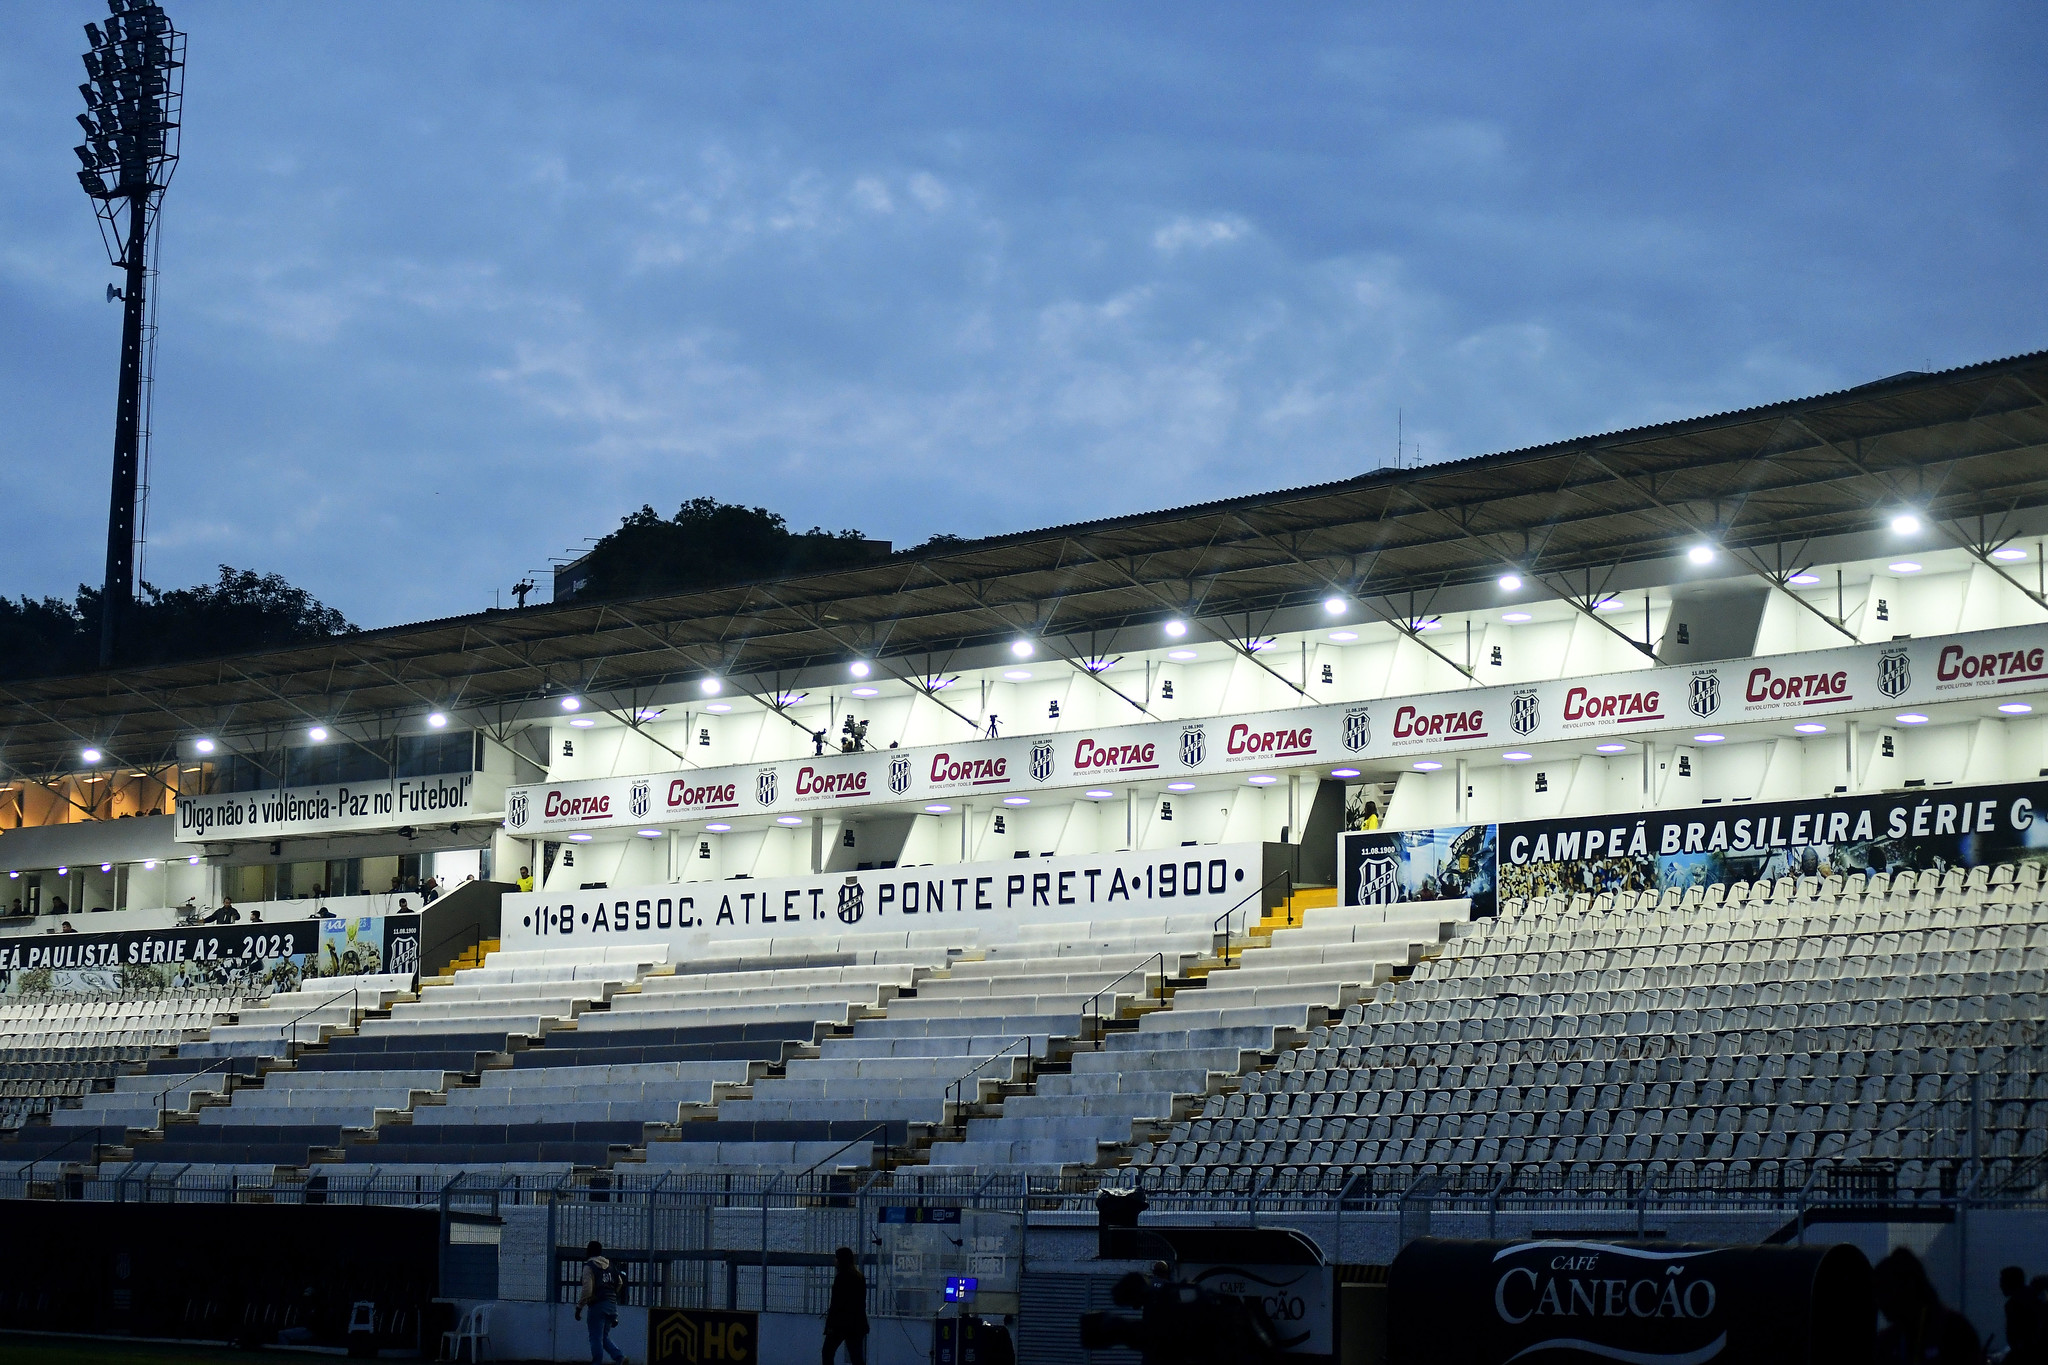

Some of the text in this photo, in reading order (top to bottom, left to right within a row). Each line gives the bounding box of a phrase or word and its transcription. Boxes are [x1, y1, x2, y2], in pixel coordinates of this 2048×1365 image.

[1880, 647, 1908, 655] 11.08.1900
[1691, 668, 1718, 676] 11.08.1900
[1881, 666, 1905, 686] AAPP
[1935, 679, 1996, 691] REVOLUTION TOOLS
[1692, 686, 1715, 705] AAPP
[1513, 705, 1535, 724] AAPP
[1744, 703, 1780, 711] REVOLUTION
[1345, 723, 1366, 741] AAPP
[1562, 721, 1596, 729] REVOLUTION
[1183, 740, 1202, 757] AAPP
[1392, 739, 1425, 747] REVOLUTION
[217, 800, 244, 826] não
[249, 798, 257, 824] à
[374, 790, 392, 815] no
[1510, 797, 2033, 865] CAMPEÃ BRASILEIRA SÉRIE C
[1361, 846, 1396, 856] 11.08.1900
[1363, 873, 1392, 898] AAPP
[715, 888, 826, 926] ATLET.
[878, 876, 993, 916] PONTE
[28, 943, 119, 969] PAULISTA
[127, 937, 187, 964] SÉRIE
[192, 938, 219, 961] A2
[242, 933, 295, 959] 2023
[393, 949, 414, 968] AAPP
[1550, 1253, 1600, 1271] CAFÉ
[1220, 1279, 1246, 1293] CAFÉ
[1494, 1265, 1717, 1325] CANECÃO
[703, 1320, 749, 1361] HC
